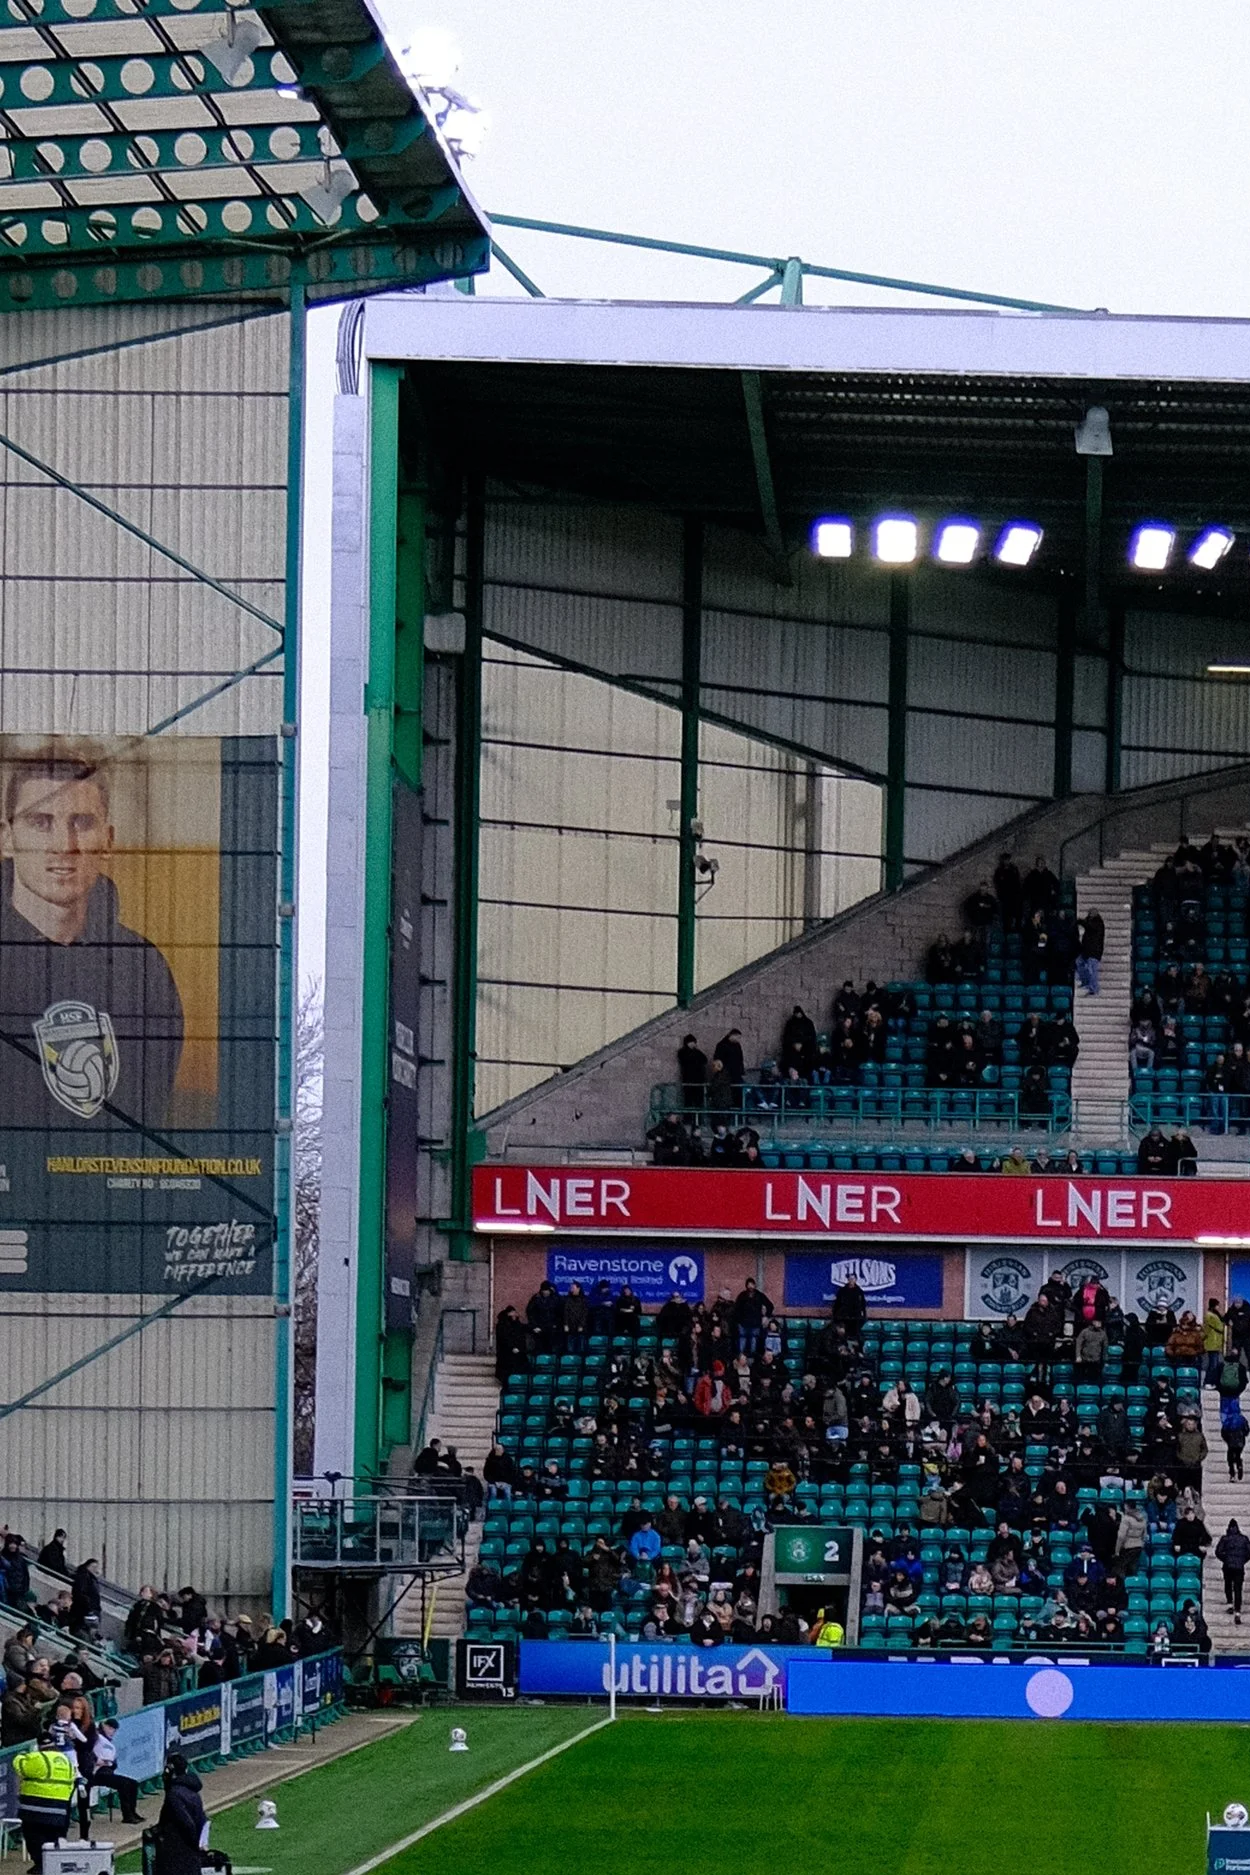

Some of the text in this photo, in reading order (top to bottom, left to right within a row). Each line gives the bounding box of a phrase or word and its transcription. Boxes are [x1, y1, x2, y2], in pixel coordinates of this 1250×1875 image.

[496, 1169, 630, 1221] LNER
[766, 1175, 901, 1230] LNER
[1036, 1181, 1172, 1235] LNER
[166, 1219, 256, 1250] TOGETHER
[163, 1260, 257, 1282] DIFFERENCE
[554, 1255, 664, 1272] Ravenstone
[824, 1541, 840, 1562] 2
[473, 1651, 497, 1677] IFX
[602, 1654, 734, 1695] utilita
